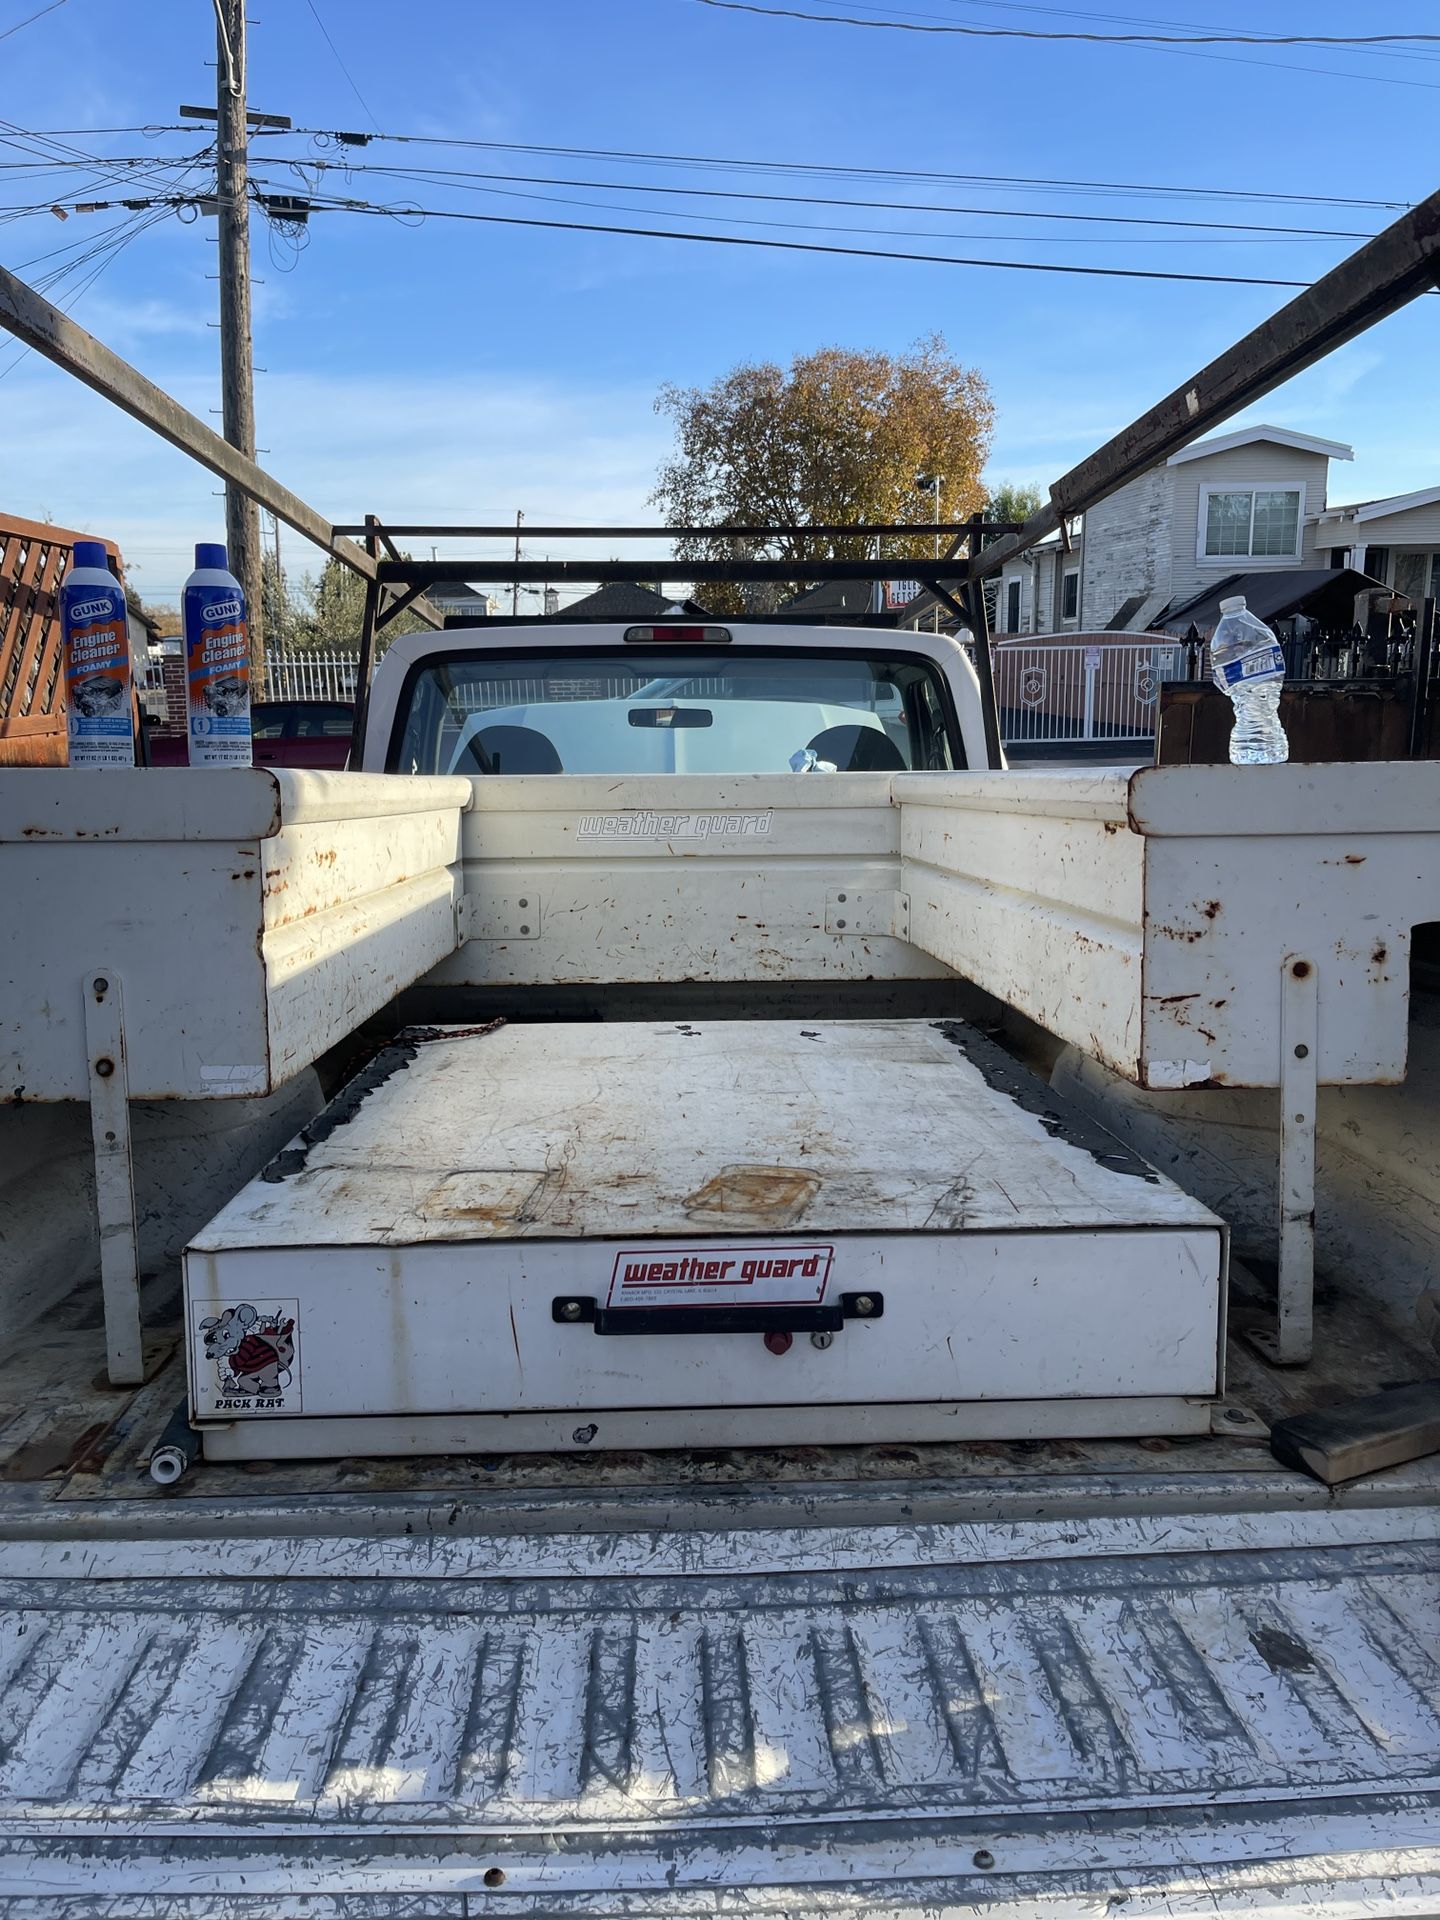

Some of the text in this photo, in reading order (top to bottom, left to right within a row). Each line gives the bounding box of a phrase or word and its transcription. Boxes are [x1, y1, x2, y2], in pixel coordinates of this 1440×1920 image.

[72, 601, 110, 617] GUNK
[205, 602, 240, 618] GUNK
[73, 631, 116, 649] Engine
[205, 632, 244, 650] Engine
[71, 643, 120, 664] Cleaner
[201, 644, 246, 664] Cleaner
[76, 660, 112, 674] FOAMY
[208, 660, 241, 675] FOAMY
[577, 810, 774, 841] weather guard
[624, 1254, 820, 1285] weather guard
[214, 1397, 284, 1409] PACK RAT
